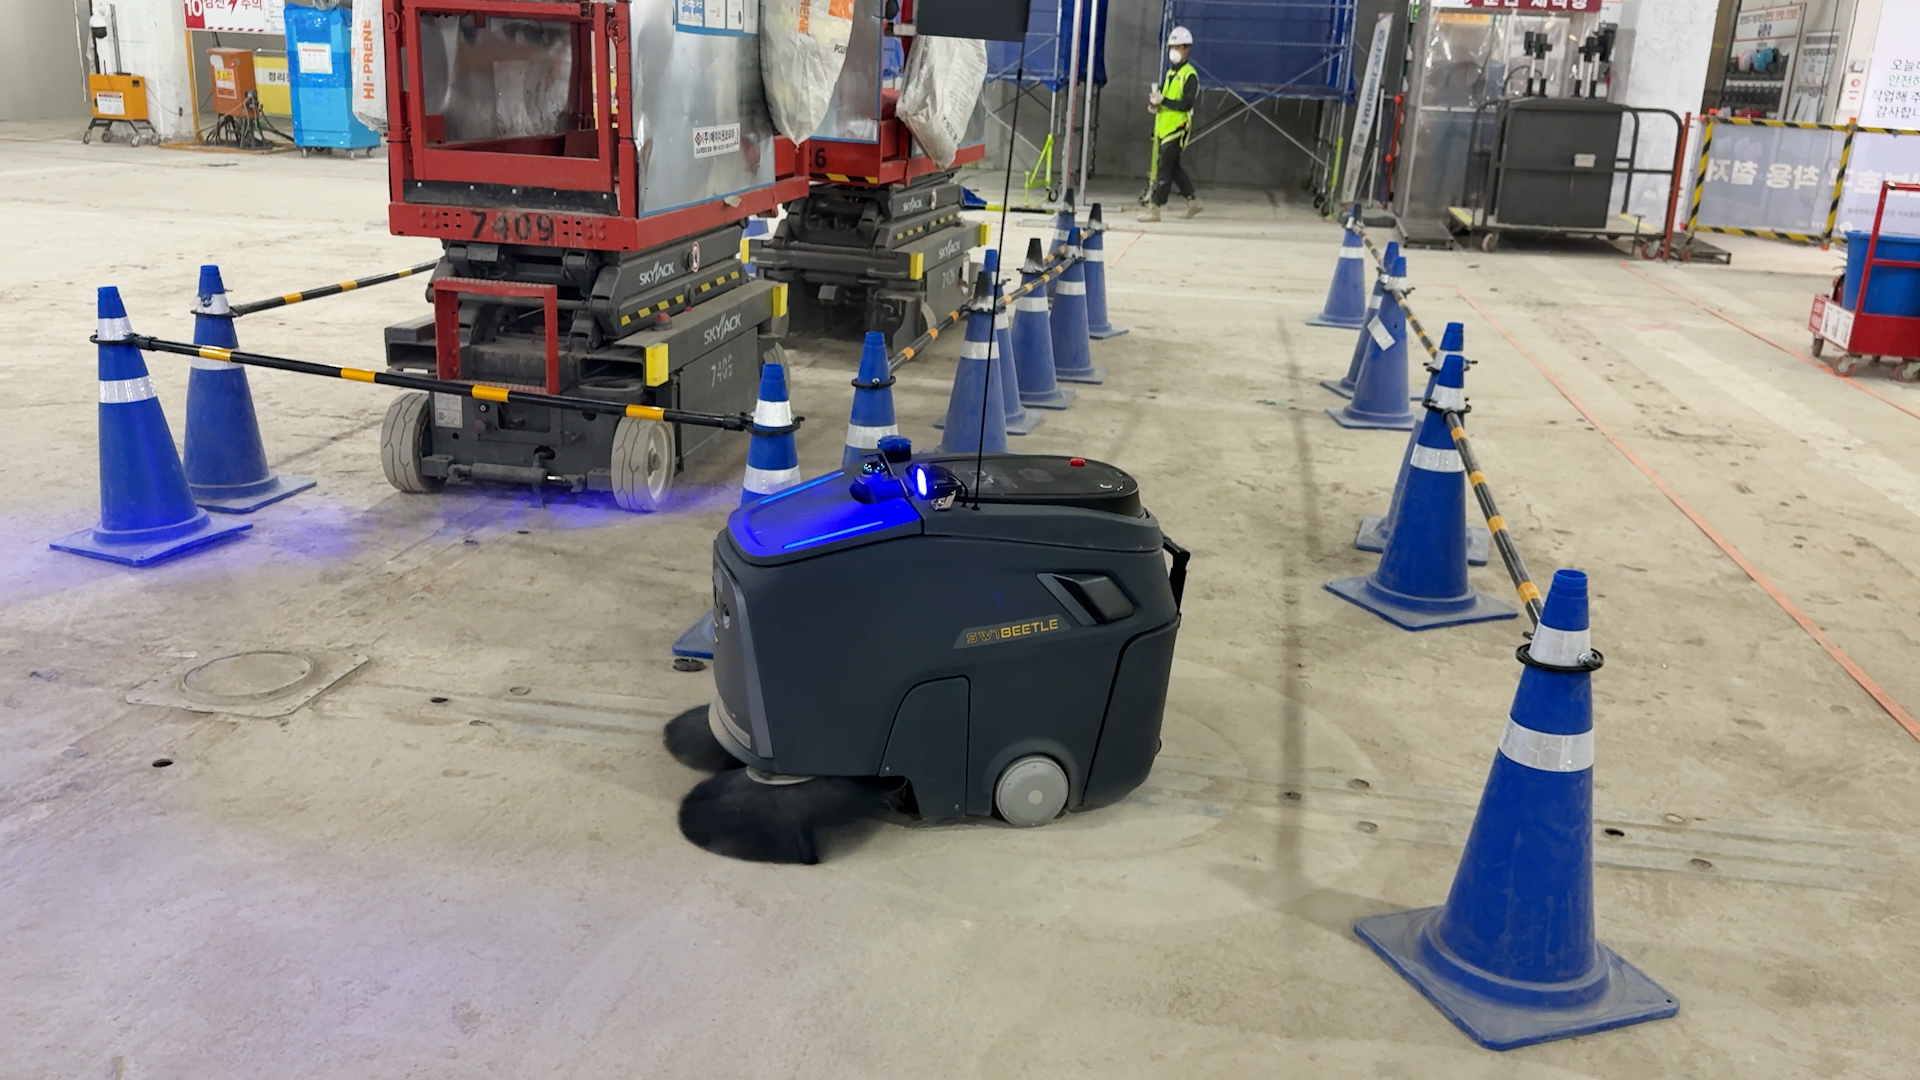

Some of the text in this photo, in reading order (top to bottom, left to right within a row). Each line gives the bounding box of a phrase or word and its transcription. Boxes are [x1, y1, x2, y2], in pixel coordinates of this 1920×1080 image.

[183, 0, 203, 16] 10
[363, 20, 375, 99] HI-PRENE
[471, 211, 554, 241] 7409
[639, 261, 675, 286] SKYJACK
[704, 312, 741, 345] SKYJACK
